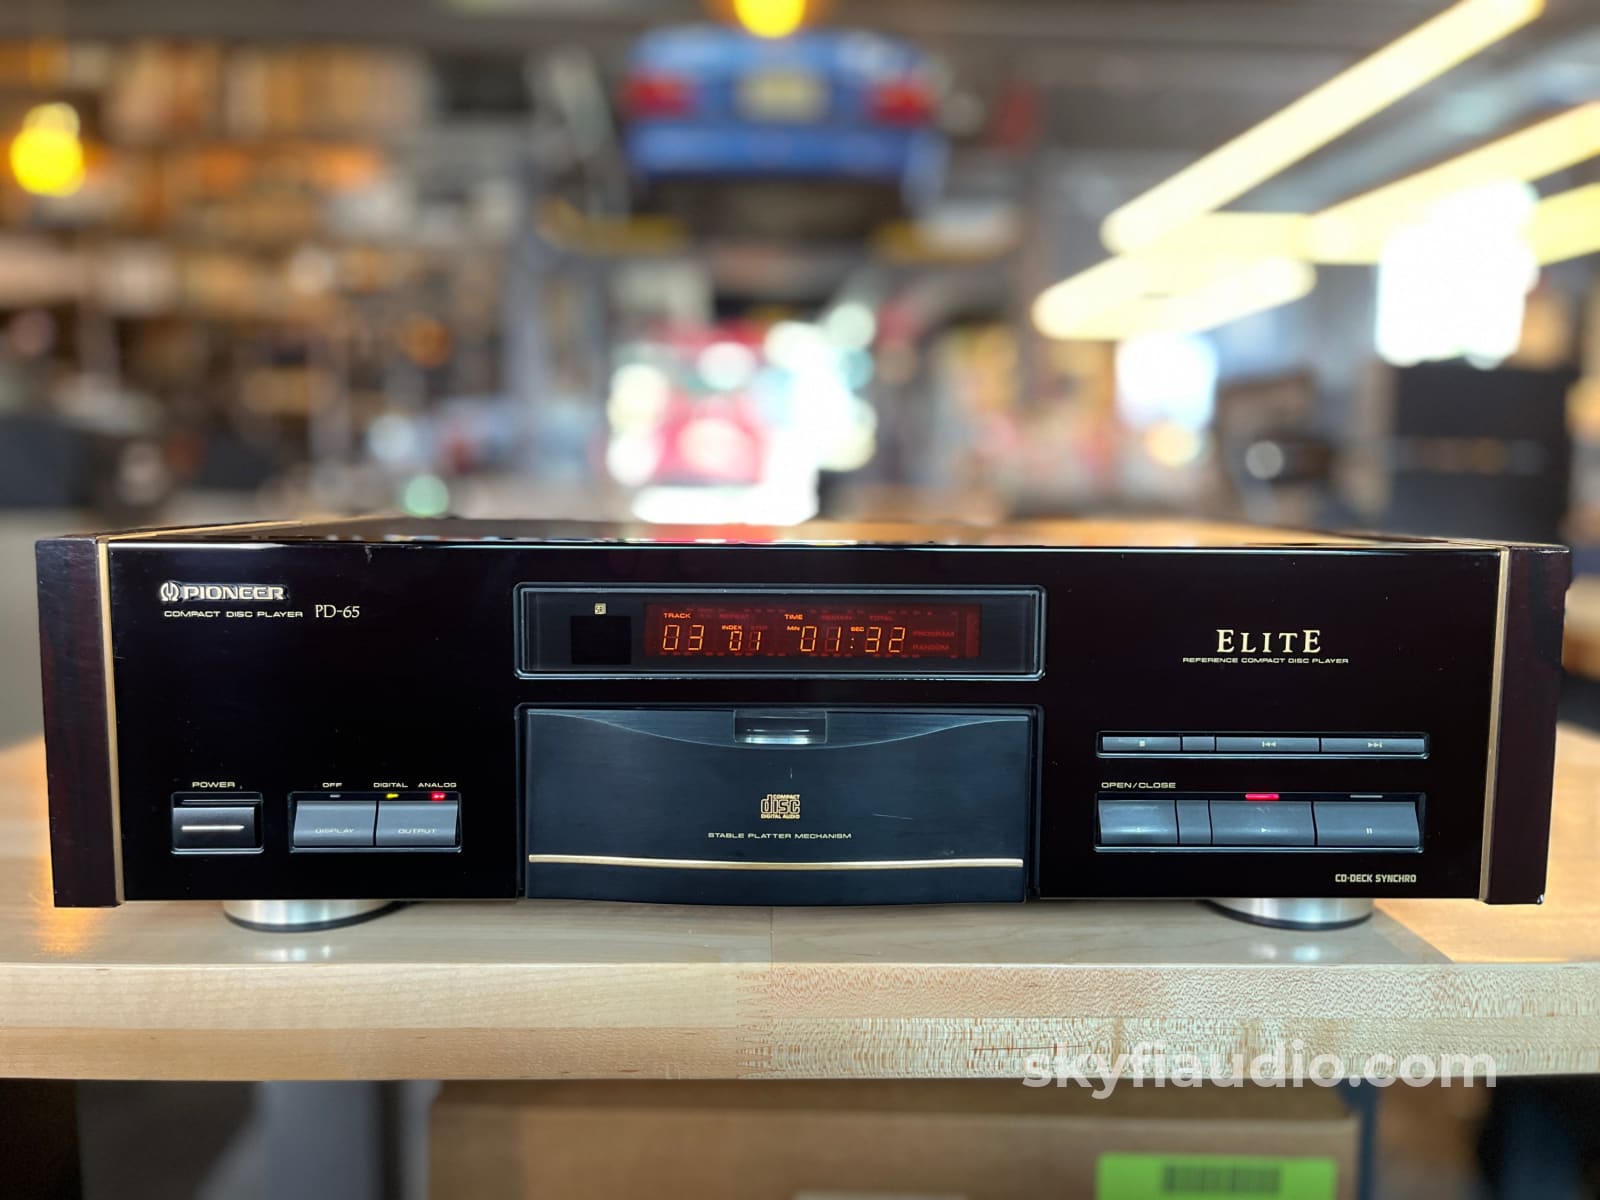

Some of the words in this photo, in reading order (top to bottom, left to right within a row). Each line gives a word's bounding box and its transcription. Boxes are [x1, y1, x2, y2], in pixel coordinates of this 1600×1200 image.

[182, 585, 285, 600] PIONEER
[164, 610, 221, 618] COMPACT
[226, 610, 253, 618] DISC
[315, 604, 360, 618] PD-65
[662, 624, 705, 651] 03
[729, 630, 761, 651] 01
[800, 625, 906, 653] 01:32
[1216, 629, 1321, 653] ELITE
[1101, 781, 1177, 789] OPEN/CLOSE
[760, 794, 801, 814] disc
[1335, 873, 1373, 883] CD-DECK
[1375, 873, 1417, 883] SYNCHRO
